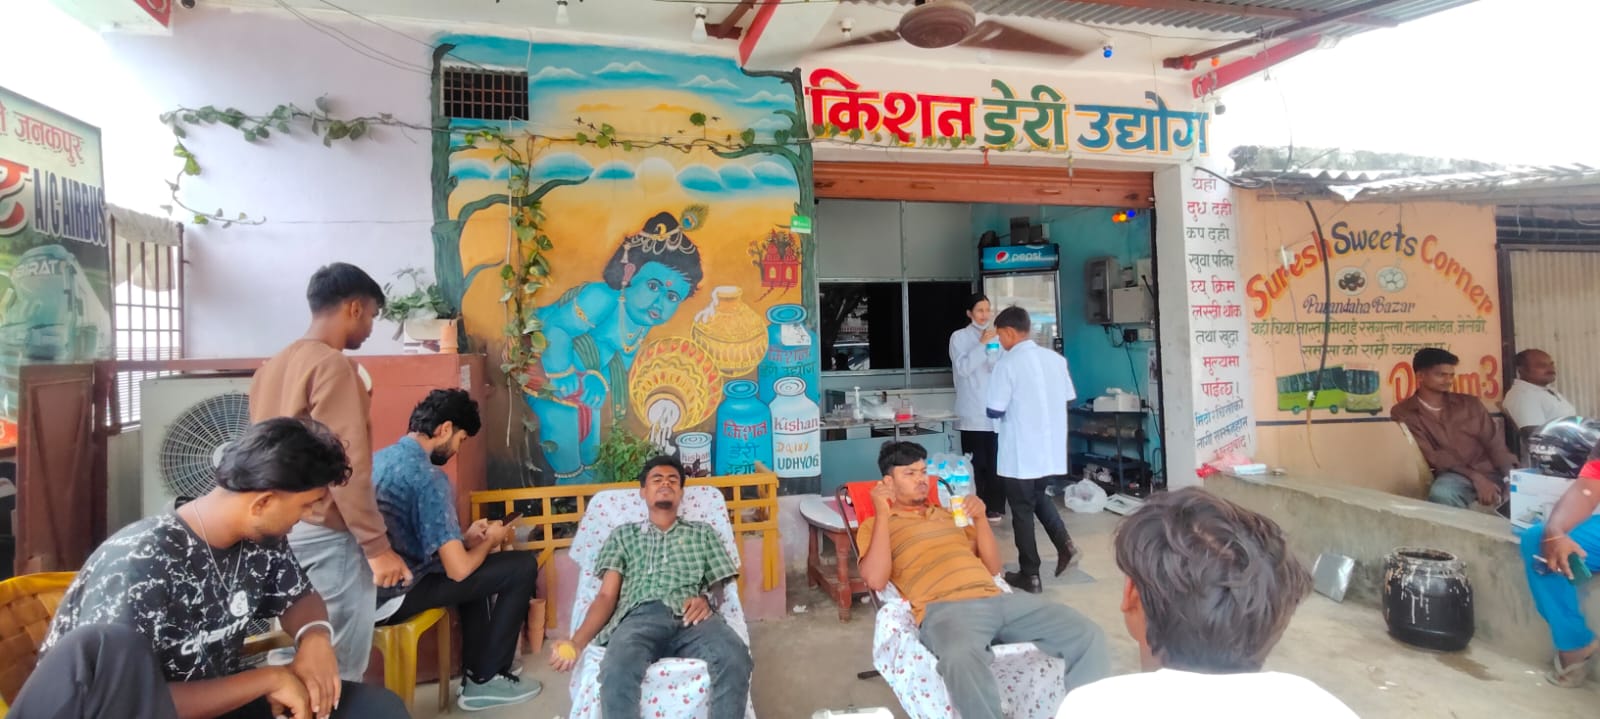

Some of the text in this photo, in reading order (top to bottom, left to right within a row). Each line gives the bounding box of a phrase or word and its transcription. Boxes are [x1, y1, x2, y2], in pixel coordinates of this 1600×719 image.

[804, 68, 1210, 154] किशन डेरी उद्योग
[13, 110, 84, 166] जनकपुर
[33, 167, 60, 236] A/C
[61, 175, 107, 247] AIRBUS
[1186, 226, 1205, 240] कप
[1011, 250, 1041, 263] pepsi
[1246, 220, 1494, 318] Suresh Sweets Corner
[1371, 296, 1416, 314] Bazar
[1195, 330, 1217, 345] तथा
[723, 419, 768, 441] किशन
[777, 454, 819, 471] UDHYOG
